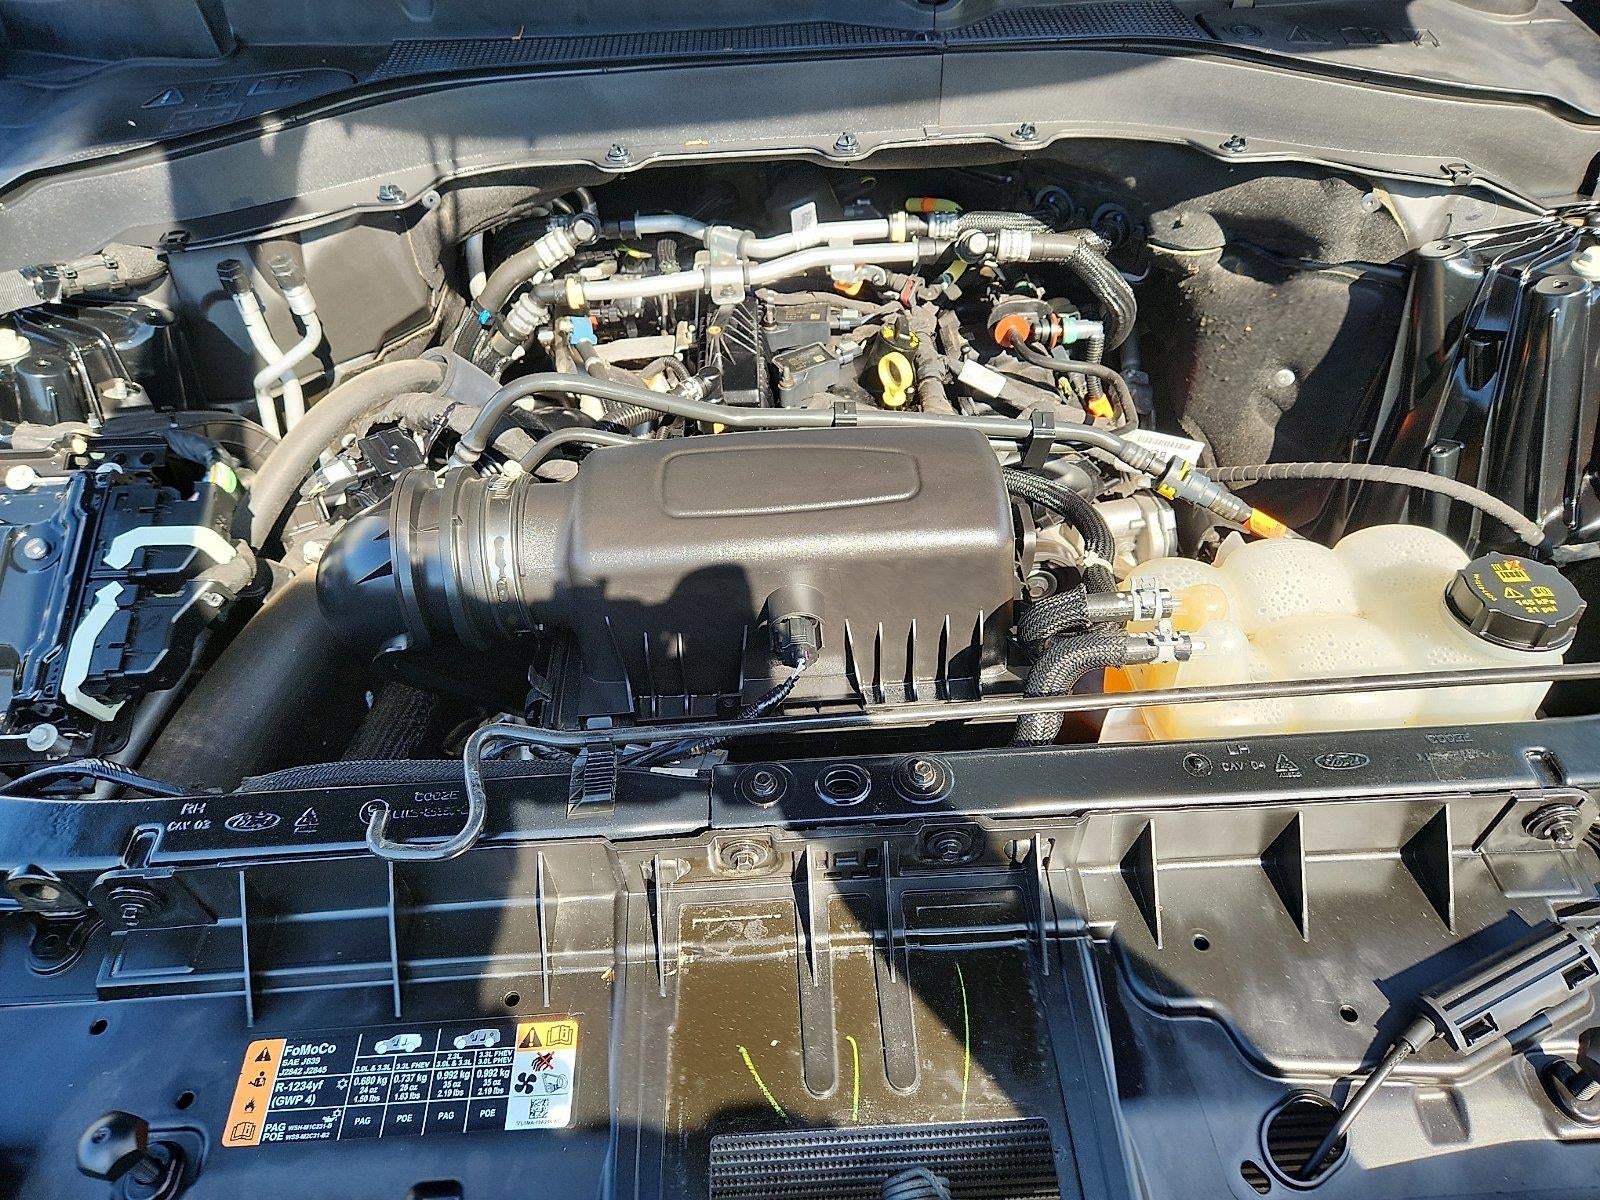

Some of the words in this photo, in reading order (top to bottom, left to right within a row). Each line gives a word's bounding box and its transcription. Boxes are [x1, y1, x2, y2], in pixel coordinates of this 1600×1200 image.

[1226, 743, 1251, 756] LH
[1221, 761, 1243, 772] CAV
[180, 802, 207, 815] RH
[166, 820, 191, 832] CAV
[283, 1043, 337, 1057] FoMoCo
[281, 1059, 300, 1067] SAE
[301, 1057, 321, 1066] J639
[279, 1067, 302, 1076] J2842
[303, 1066, 328, 1075] J2845
[436, 1070, 459, 1080] 0.992
[459, 1070, 470, 1080] kg
[476, 1068, 499, 1078] 0.992
[499, 1067, 510, 1078] kg
[353, 1076, 376, 1086] 0.680
[376, 1075, 388, 1086] kg
[393, 1074, 416, 1083] 0.737
[417, 1073, 428, 1083] kg
[275, 1080, 325, 1092] R-1234yf
[271, 1094, 303, 1108] (GWP
[304, 1094, 316, 1107] 4)
[396, 1114, 413, 1123] POE
[437, 1111, 455, 1120] PAG
[479, 1109, 496, 1118] POE
[354, 1117, 371, 1125] PAG
[264, 1123, 286, 1132] PAG
[262, 1132, 285, 1141] POE
